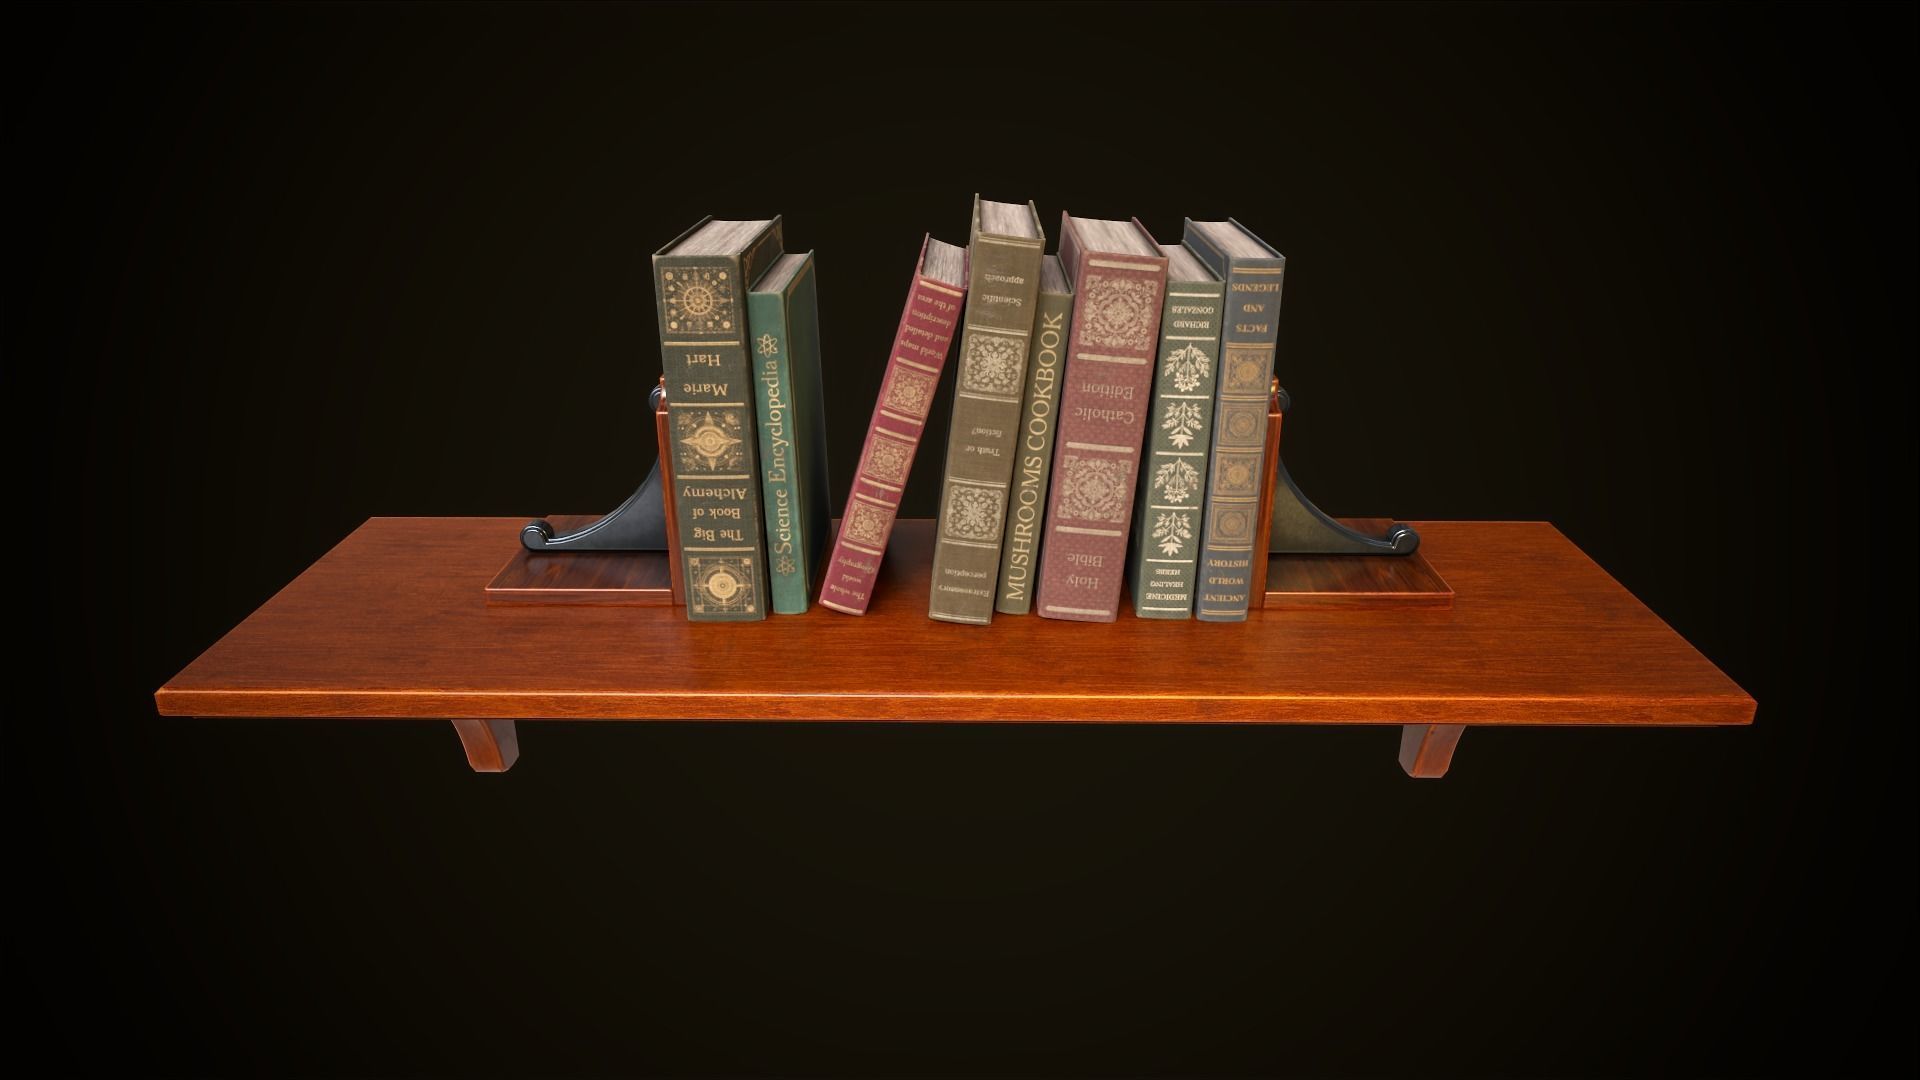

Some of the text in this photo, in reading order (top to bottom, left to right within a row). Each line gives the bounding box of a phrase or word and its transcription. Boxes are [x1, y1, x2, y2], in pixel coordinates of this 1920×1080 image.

[984, 273, 1024, 285] approach
[1231, 283, 1280, 292] LEGENDS
[917, 294, 955, 312] of the area
[982, 294, 1022, 307] Scientific
[1171, 306, 1214, 314] GONZALES
[1243, 303, 1264, 313] AND
[911, 309, 952, 328] description
[1173, 320, 1210, 329] RICHARD
[904, 324, 948, 343] and detailed
[1236, 324, 1268, 333] FACTS
[900, 339, 943, 361] World maps
[686, 354, 721, 367] Hart
[683, 383, 728, 396] Marie
[1082, 383, 1134, 399] Edition
[1074, 407, 1135, 424] Catholic
[971, 427, 1002, 437] fiction?
[761, 360, 792, 554] Science Encyclopedia
[977, 446, 1000, 457] Truth
[1006, 312, 1062, 600] MUSHROOMS COOKBOOK
[683, 486, 747, 500] Alchemy
[692, 507, 741, 520] Book of
[693, 527, 744, 542] The Big
[838, 556, 875, 574] Geography
[1066, 553, 1104, 567] Bible
[1207, 559, 1249, 568] HISTORY
[841, 574, 862, 583] world
[945, 568, 987, 579] perception
[1066, 575, 1099, 590] Holy
[1209, 577, 1245, 585] WORLD
[830, 584, 865, 601] The whole
[1145, 592, 1188, 601] MEDICINE
[1204, 593, 1246, 603] ANCIENT
